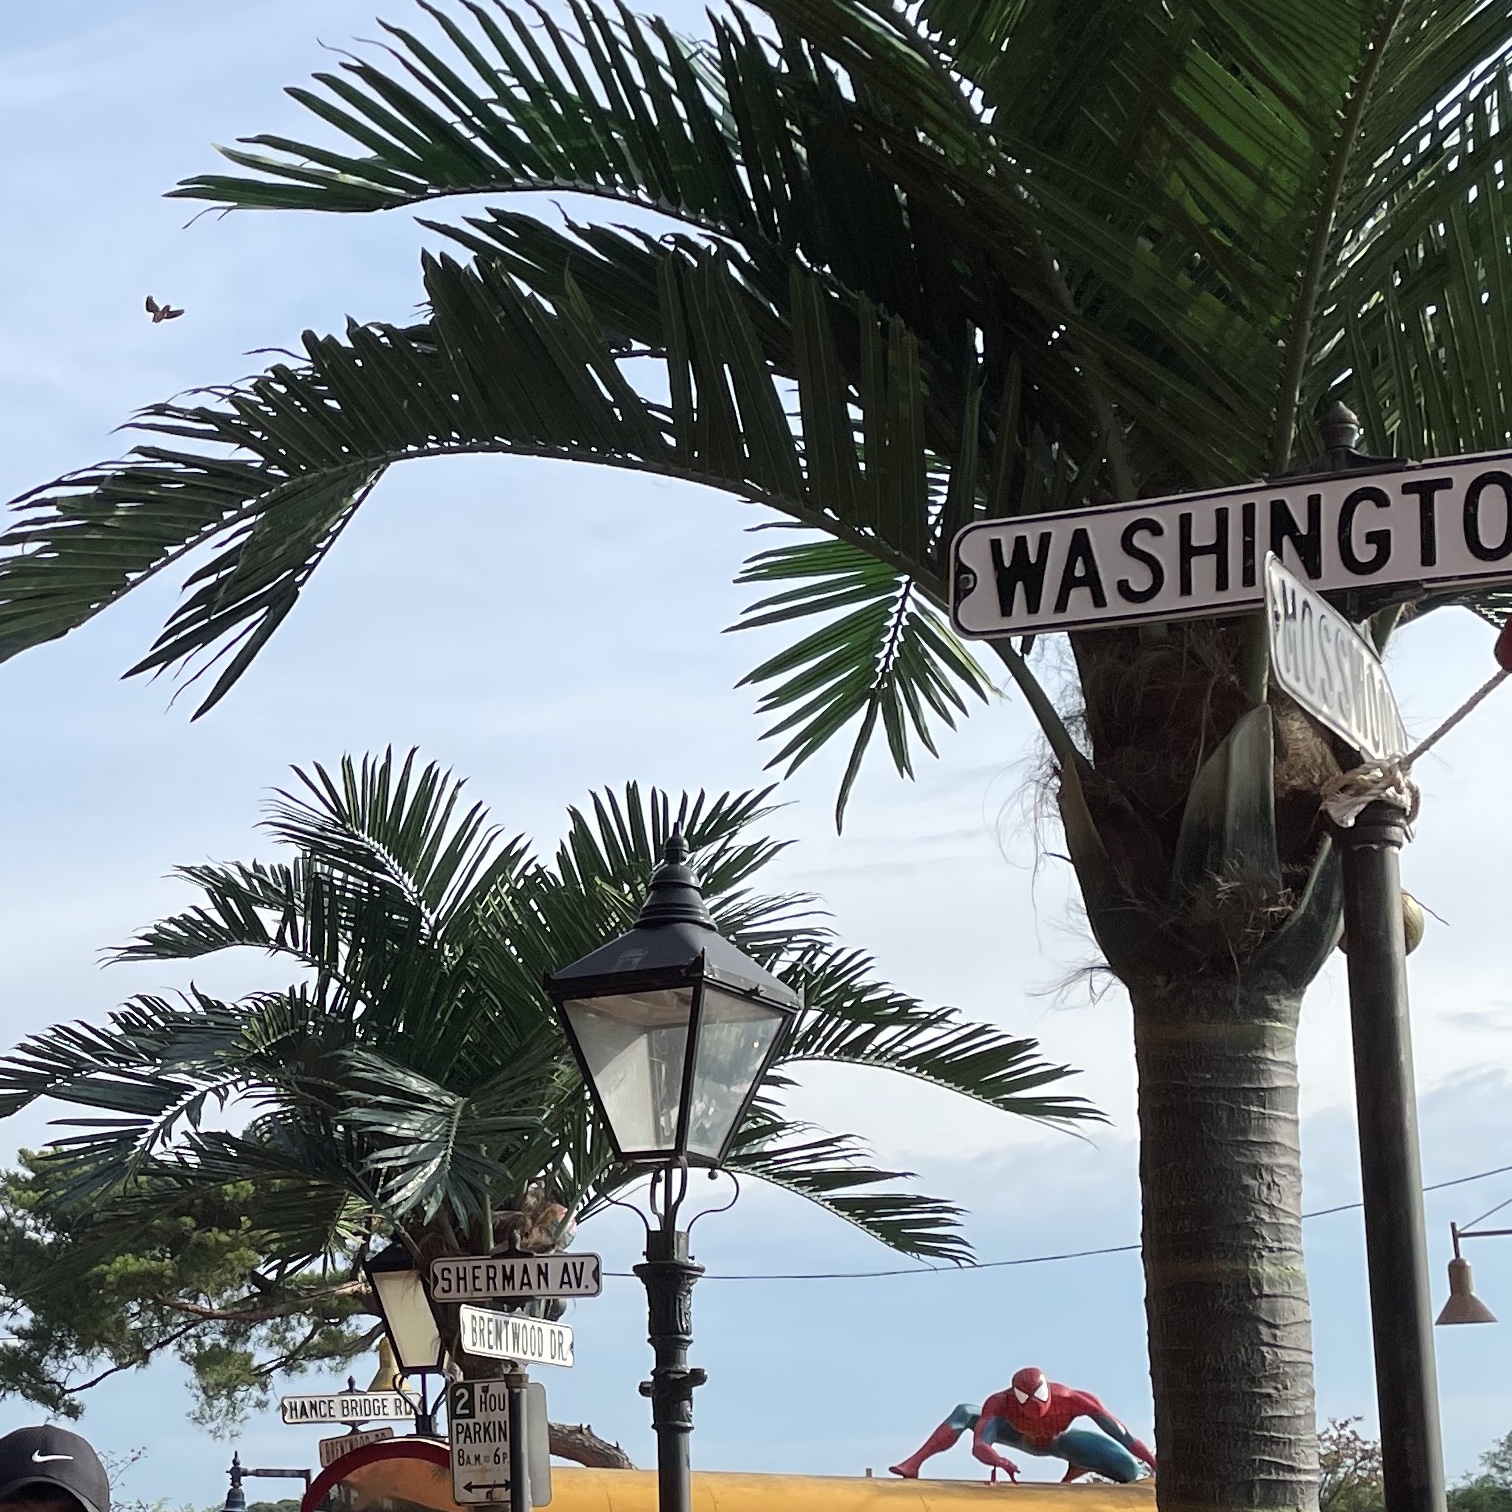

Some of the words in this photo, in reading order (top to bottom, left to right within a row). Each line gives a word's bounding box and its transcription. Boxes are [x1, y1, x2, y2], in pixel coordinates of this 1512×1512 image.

[989, 470, 1512, 618] WASHINGTO
[441, 1262, 549, 1294] SHERMAN
[559, 1261, 589, 1289] AV.
[471, 1314, 544, 1357] BRENTWOOD
[289, 1399, 337, 1419] HANCE
[341, 1397, 390, 1418] BRIDGE
[455, 1388, 470, 1415] 2
[479, 1393, 506, 1413] HOU
[455, 1420, 508, 1445] PARKIN
